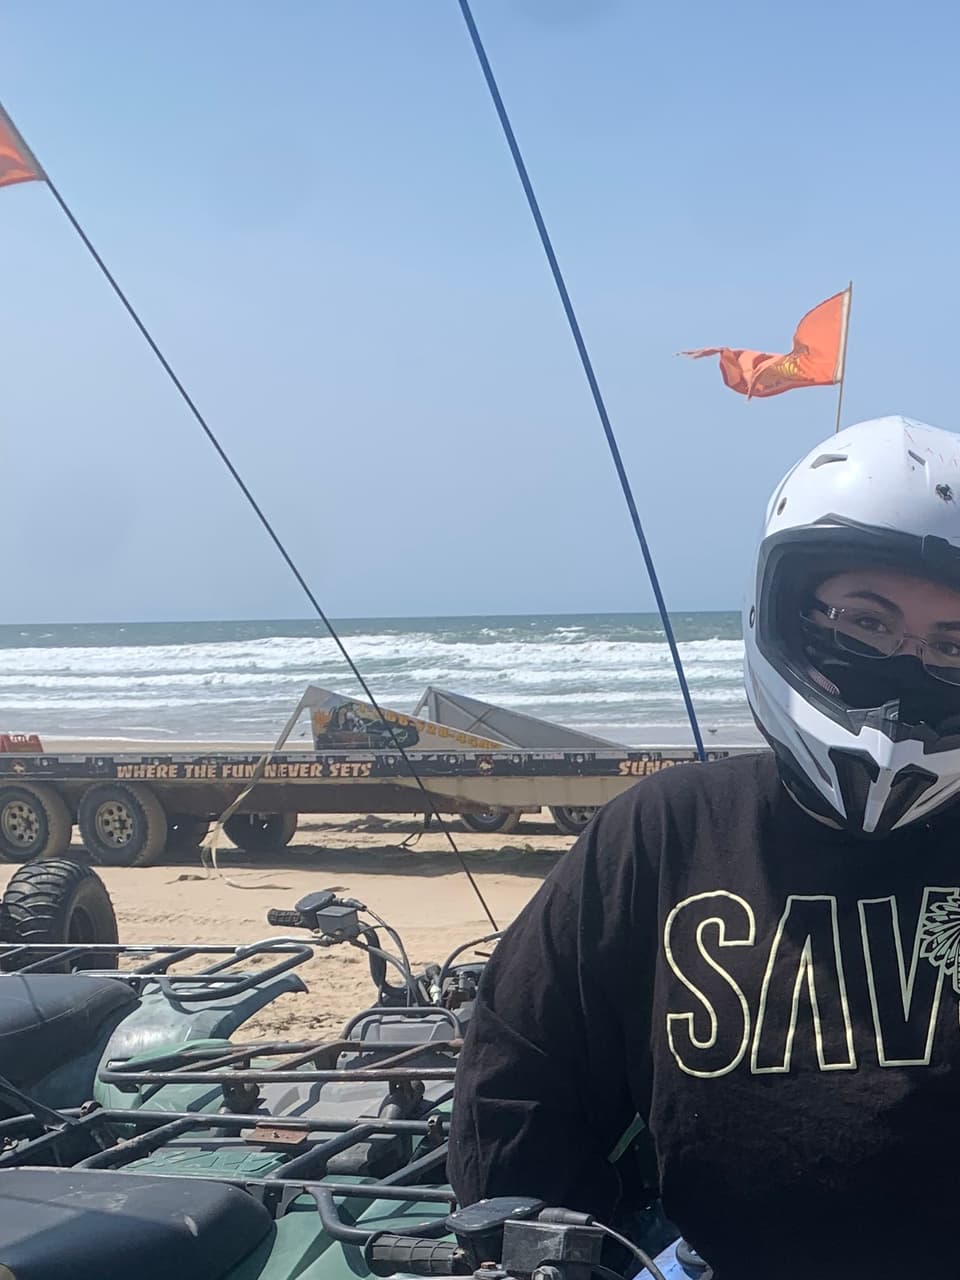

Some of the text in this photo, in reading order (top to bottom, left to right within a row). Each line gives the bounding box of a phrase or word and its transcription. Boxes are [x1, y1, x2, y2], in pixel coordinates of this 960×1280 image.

[117, 764, 178, 778] WHERE
[184, 763, 217, 778] THE
[264, 763, 323, 778] NEVER
[328, 763, 372, 777] SETS
